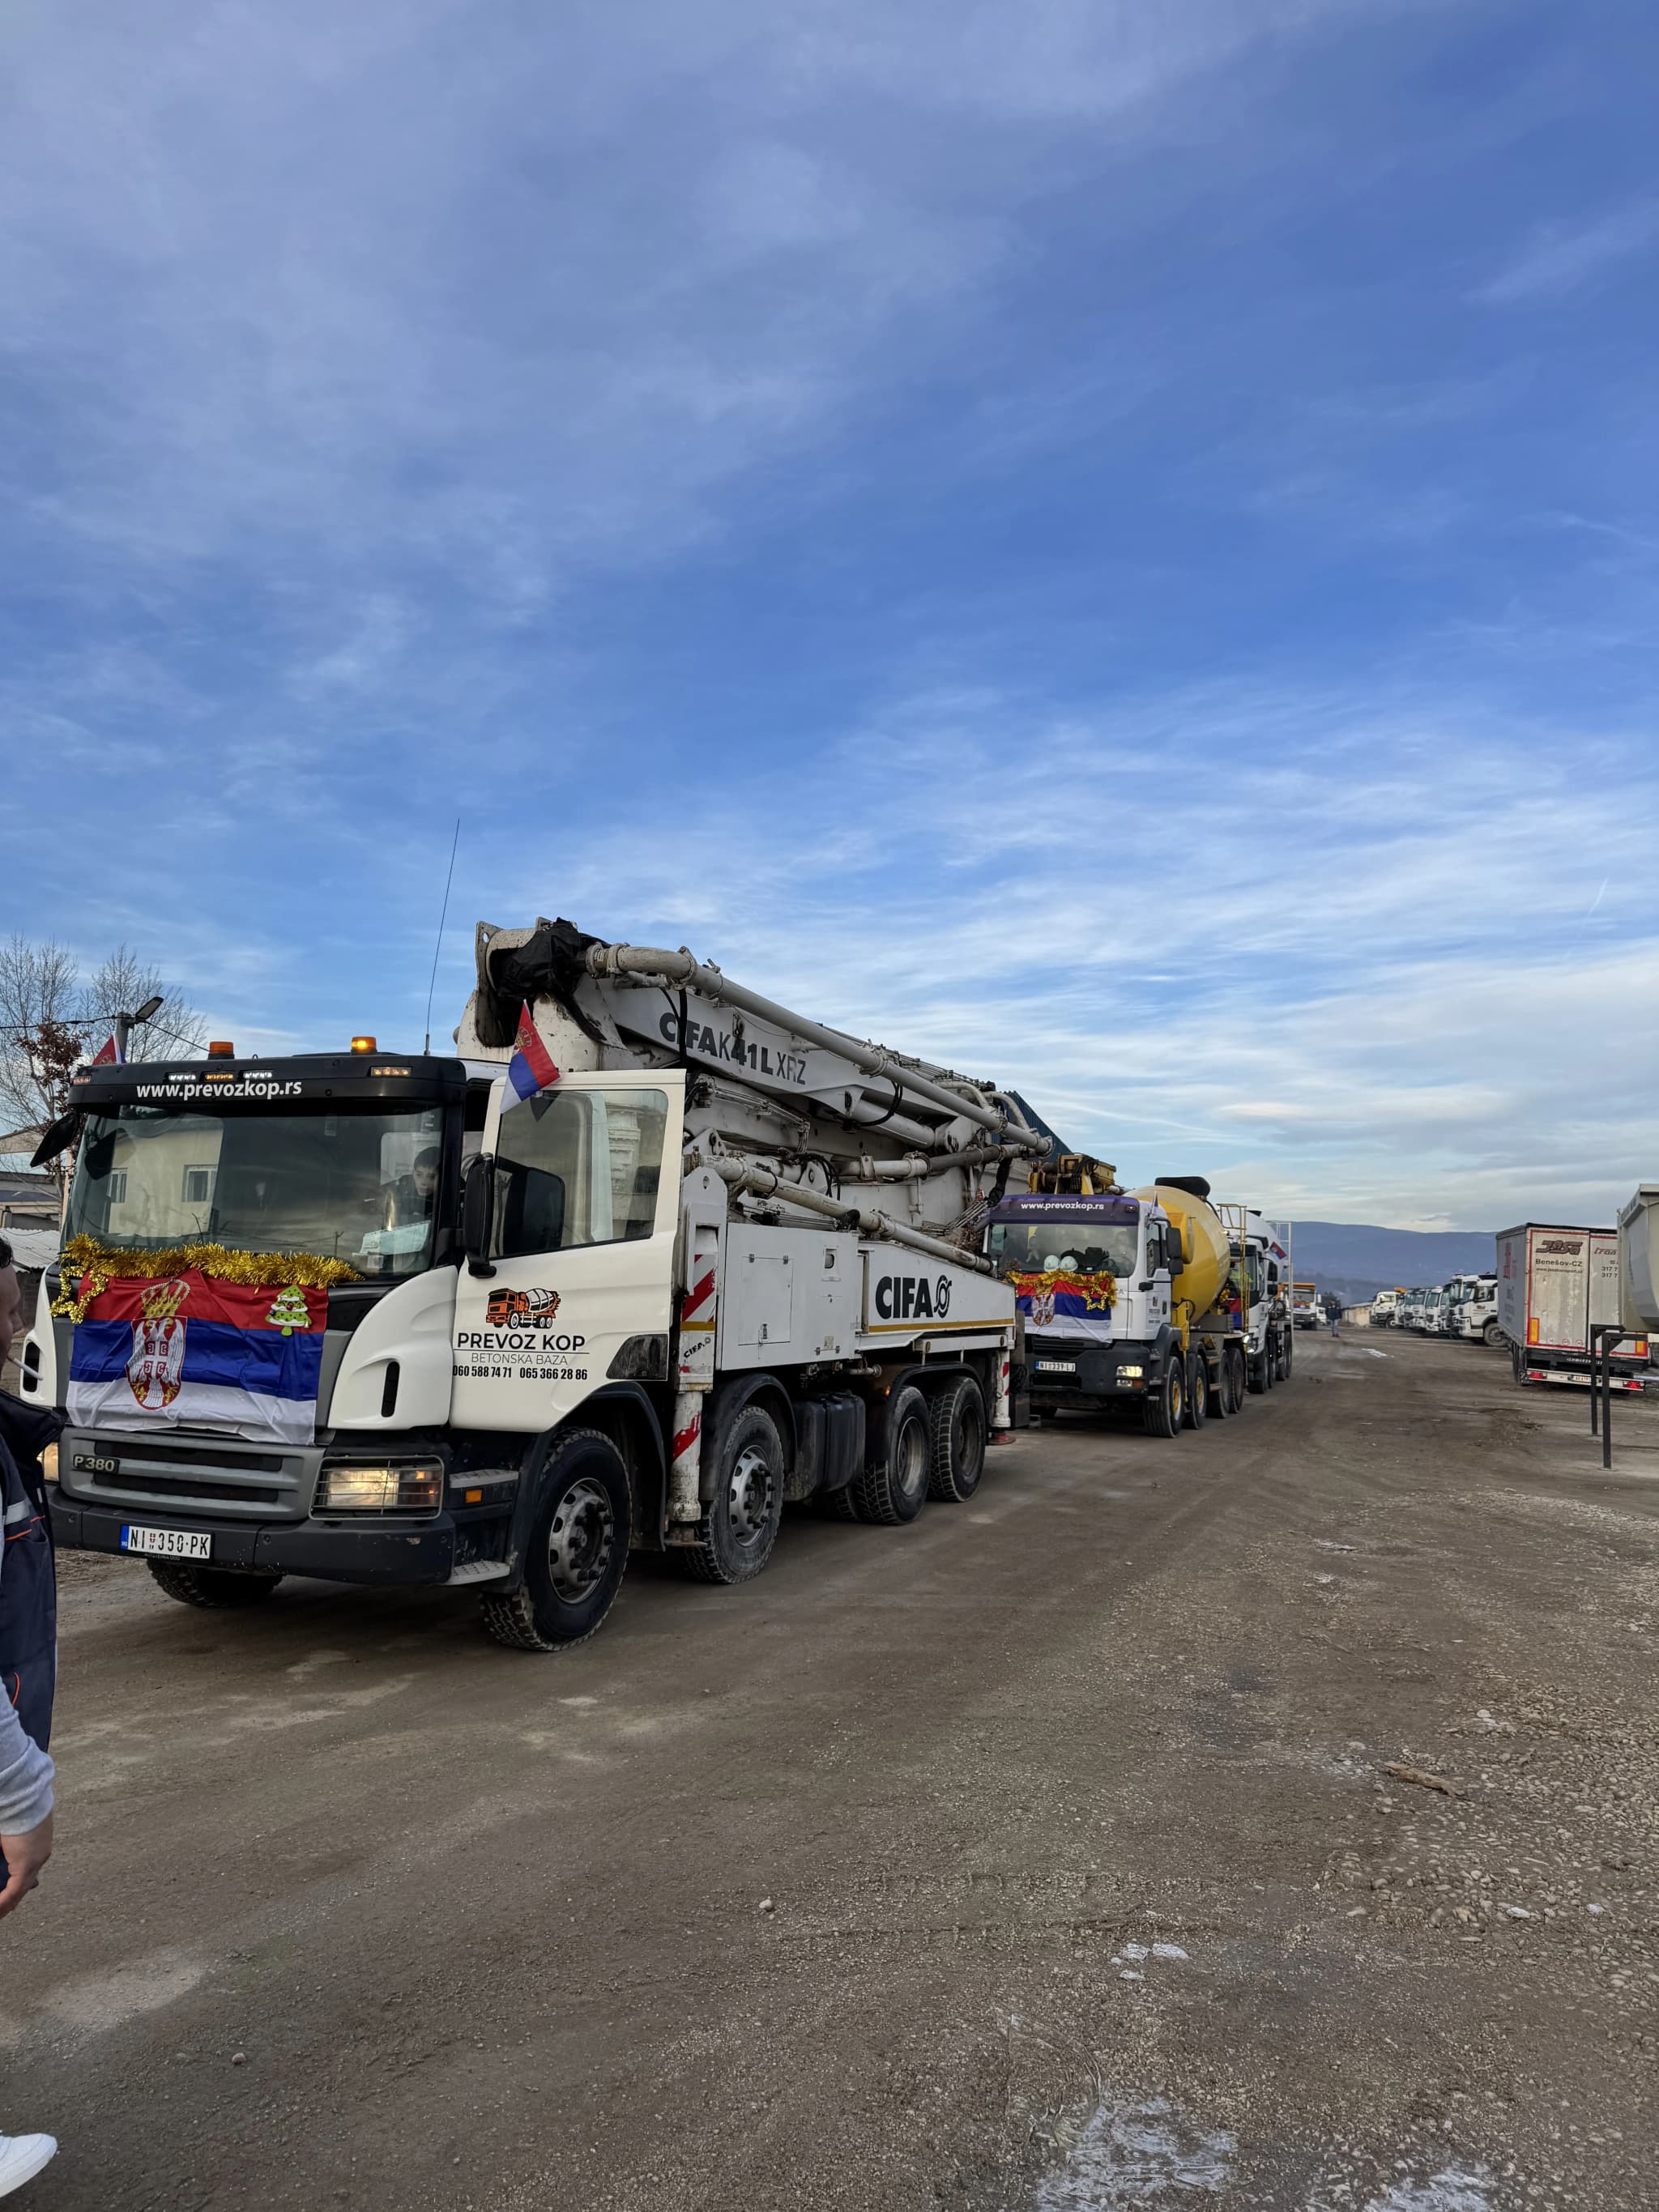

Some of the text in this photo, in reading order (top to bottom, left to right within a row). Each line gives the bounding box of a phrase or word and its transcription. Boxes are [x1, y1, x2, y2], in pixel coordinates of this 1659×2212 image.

[777, 1052, 806, 1085] XRZ
[137, 1080, 302, 1101] www.prevozkop.rs
[1021, 1201, 1105, 1211] www.prevozkop.rs
[1594, 1247, 1618, 1255] tran
[875, 1276, 933, 1319] CIFA
[457, 1332, 586, 1351] PREVOZ KOP
[684, 1342, 705, 1358] CIFA
[471, 1353, 568, 1365] BETONSKA BAZA
[453, 1366, 588, 1380] 060 588 74 71 065 366 28 86
[75, 1455, 114, 1472] P 380
[130, 1529, 145, 1549] NI
